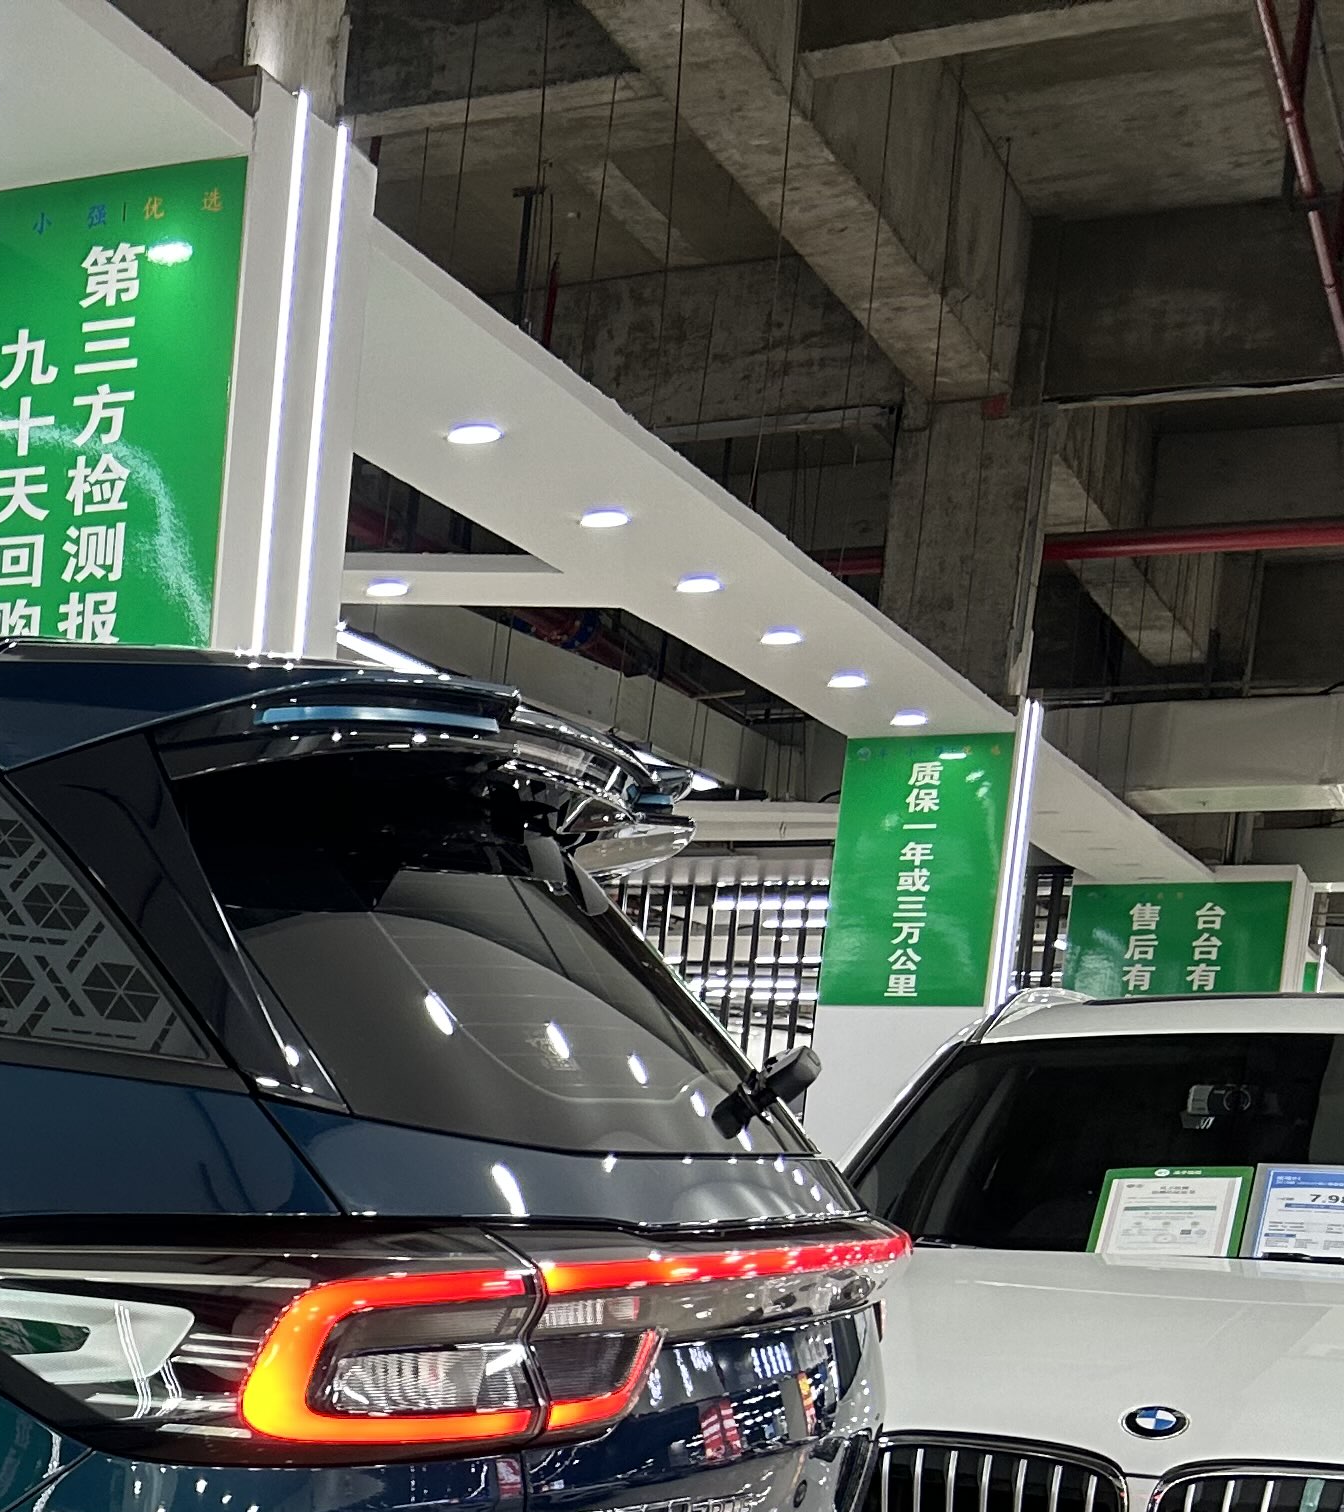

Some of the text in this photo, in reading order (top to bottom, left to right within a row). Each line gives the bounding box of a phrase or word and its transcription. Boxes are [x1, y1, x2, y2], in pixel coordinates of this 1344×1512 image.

[57, 242, 148, 644] 第三方检测报
[884, 761, 945, 998] 质保一年或三万公里
[1122, 902, 1161, 998] 售后有
[1186, 902, 1227, 991] 台台有
